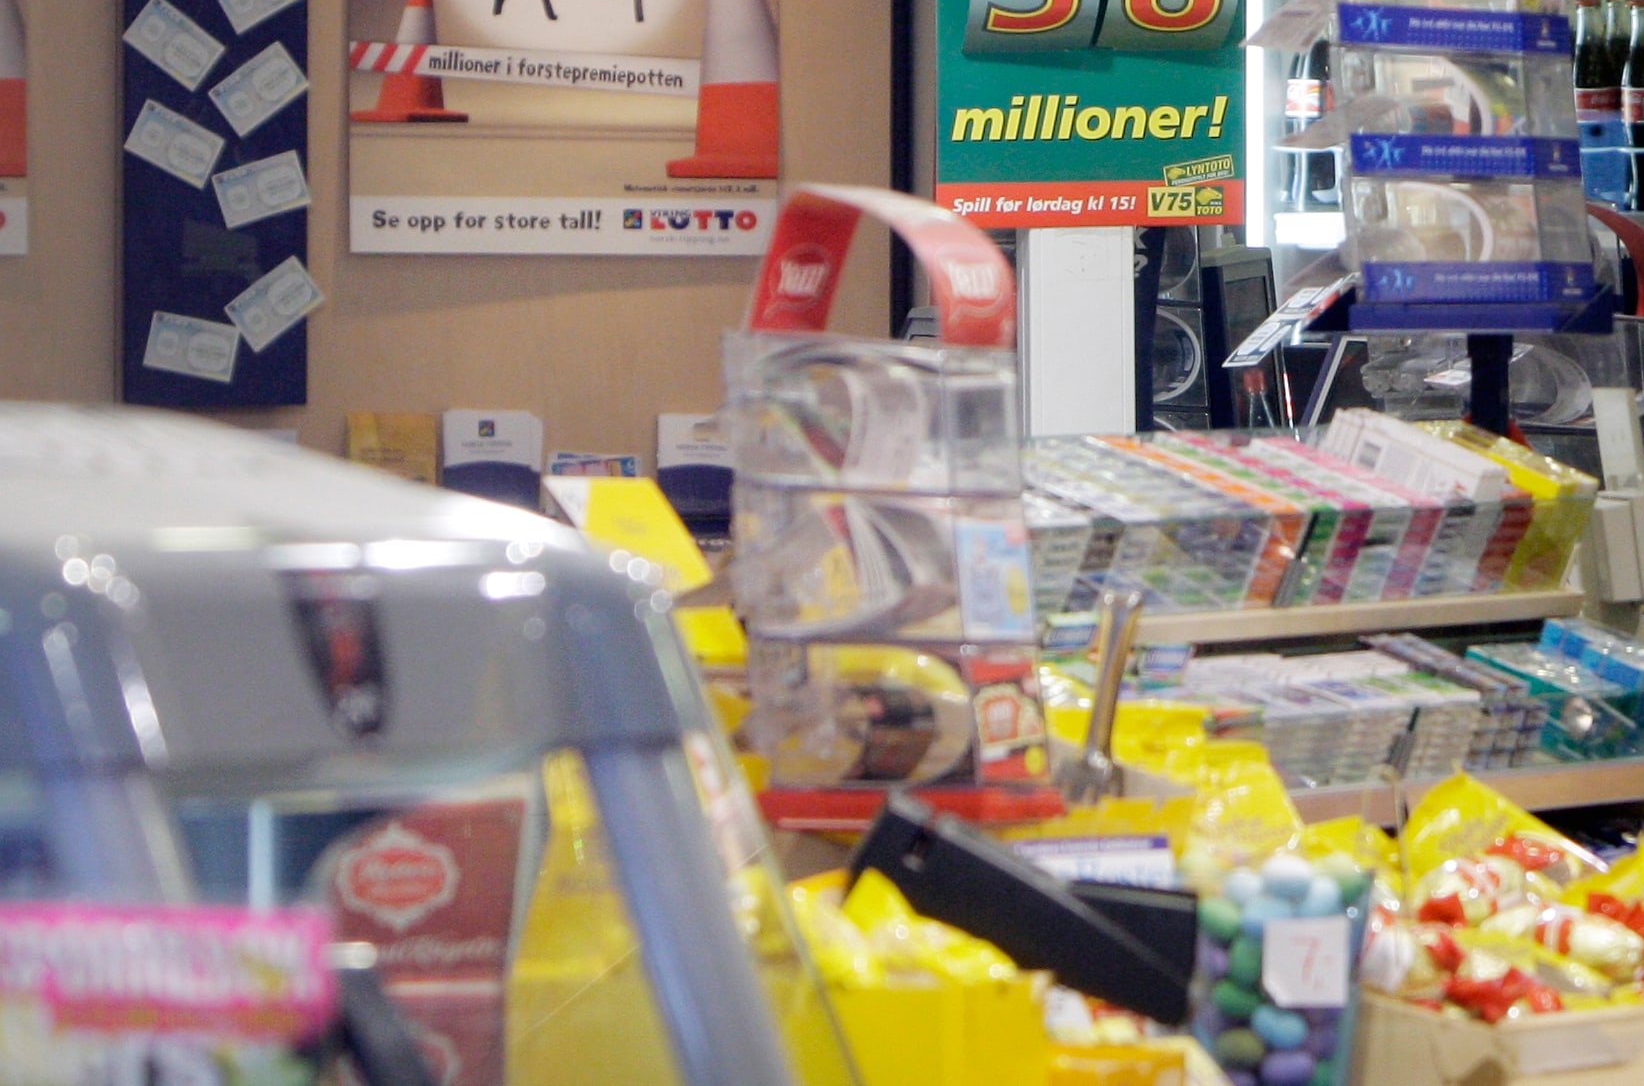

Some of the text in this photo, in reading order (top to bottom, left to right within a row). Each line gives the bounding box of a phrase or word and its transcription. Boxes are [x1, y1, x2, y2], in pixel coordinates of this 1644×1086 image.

[429, 50, 500, 75] millioner
[506, 56, 512, 74] i
[951, 95, 1228, 142] millioner!
[1187, 158, 1230, 176] LYNTOTO
[952, 196, 1136, 215] Spill før lørdag kl 15!
[1151, 192, 1192, 211] V75
[1197, 206, 1222, 215] TOTO
[372, 209, 601, 232] Se opp for store tall!
